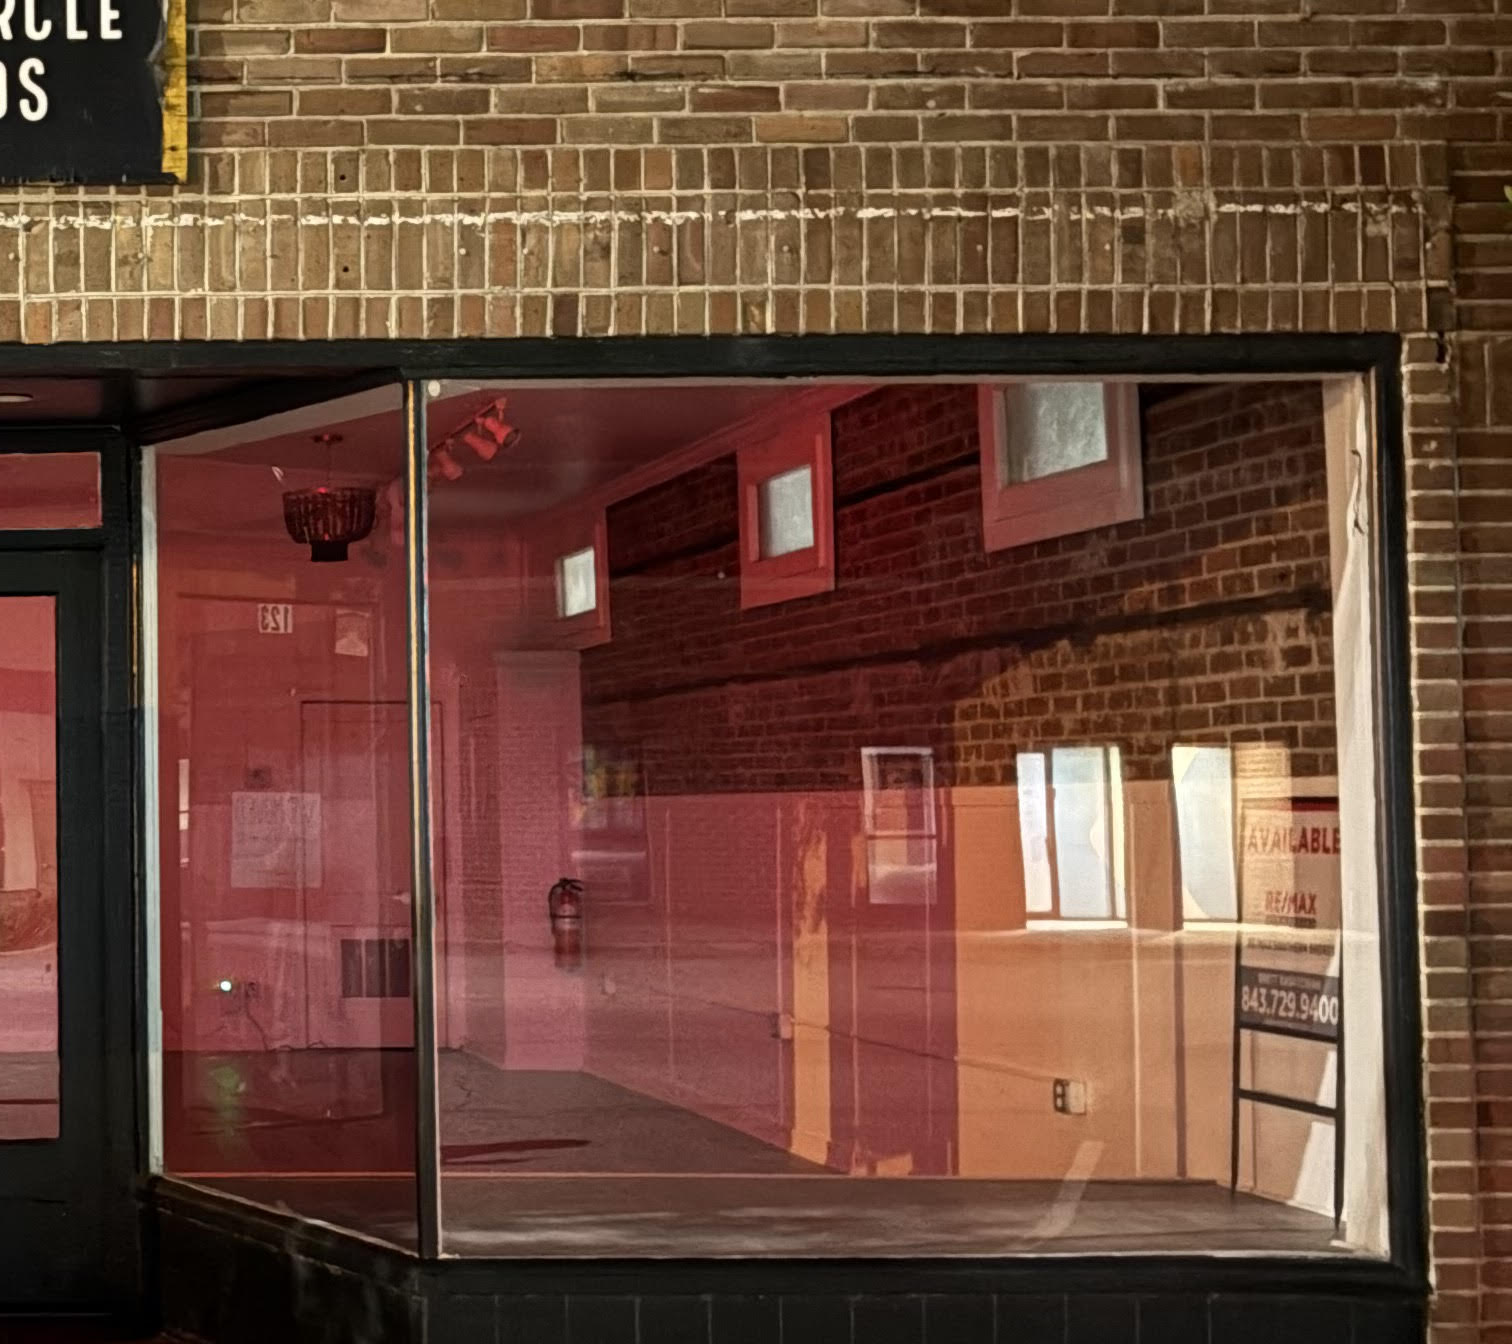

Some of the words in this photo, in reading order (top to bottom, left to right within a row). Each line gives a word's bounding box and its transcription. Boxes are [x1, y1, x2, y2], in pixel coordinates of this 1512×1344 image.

[1247, 825, 1340, 856] AVAILABLE
[1265, 890, 1317, 916] RE/MAX
[1241, 985, 1338, 1025] 843.729.9400
